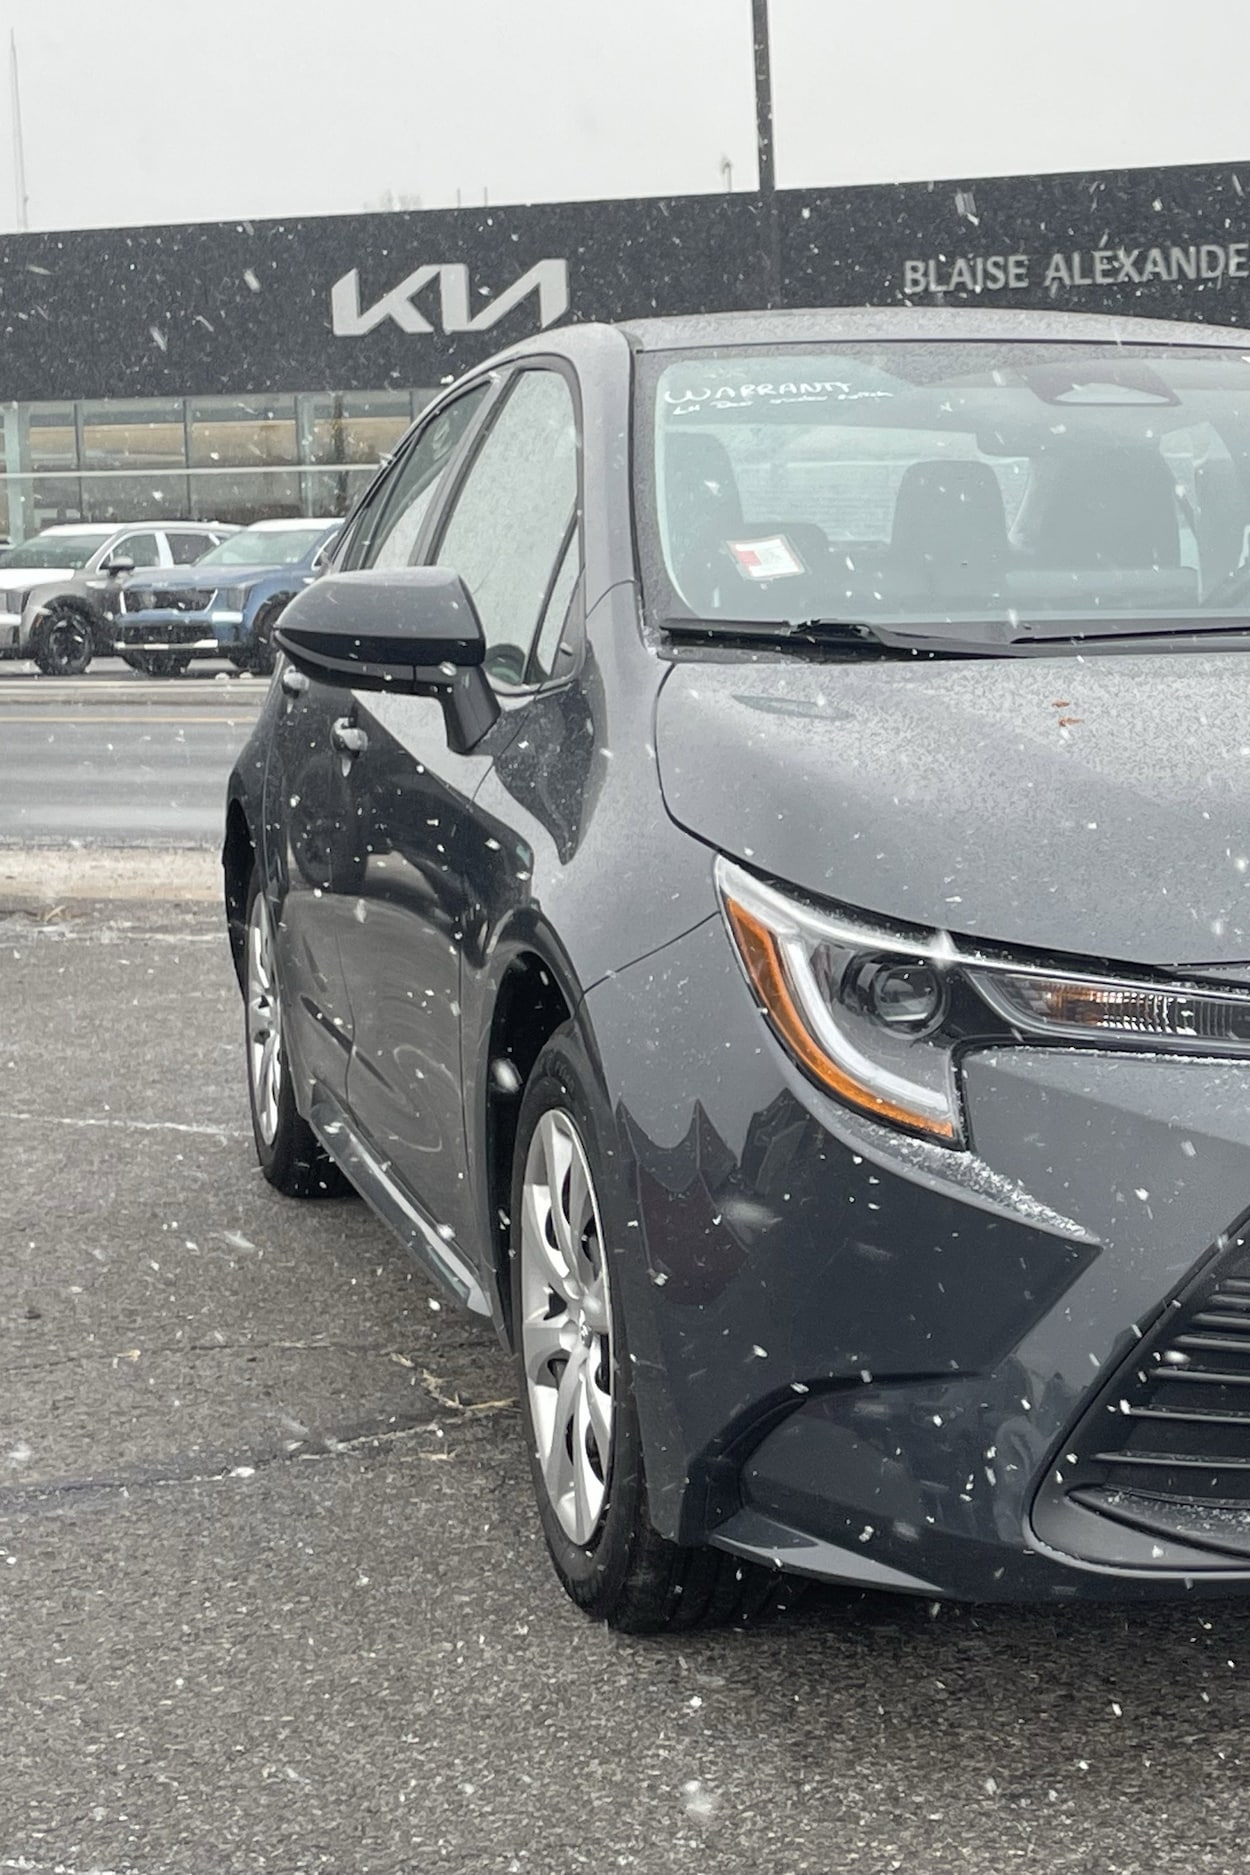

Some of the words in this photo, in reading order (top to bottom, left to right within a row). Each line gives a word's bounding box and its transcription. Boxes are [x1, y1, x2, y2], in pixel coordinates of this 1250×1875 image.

[903, 254, 1030, 294] BLAISE
[331, 258, 570, 337] KIA
[664, 381, 852, 404] WARRANTY
